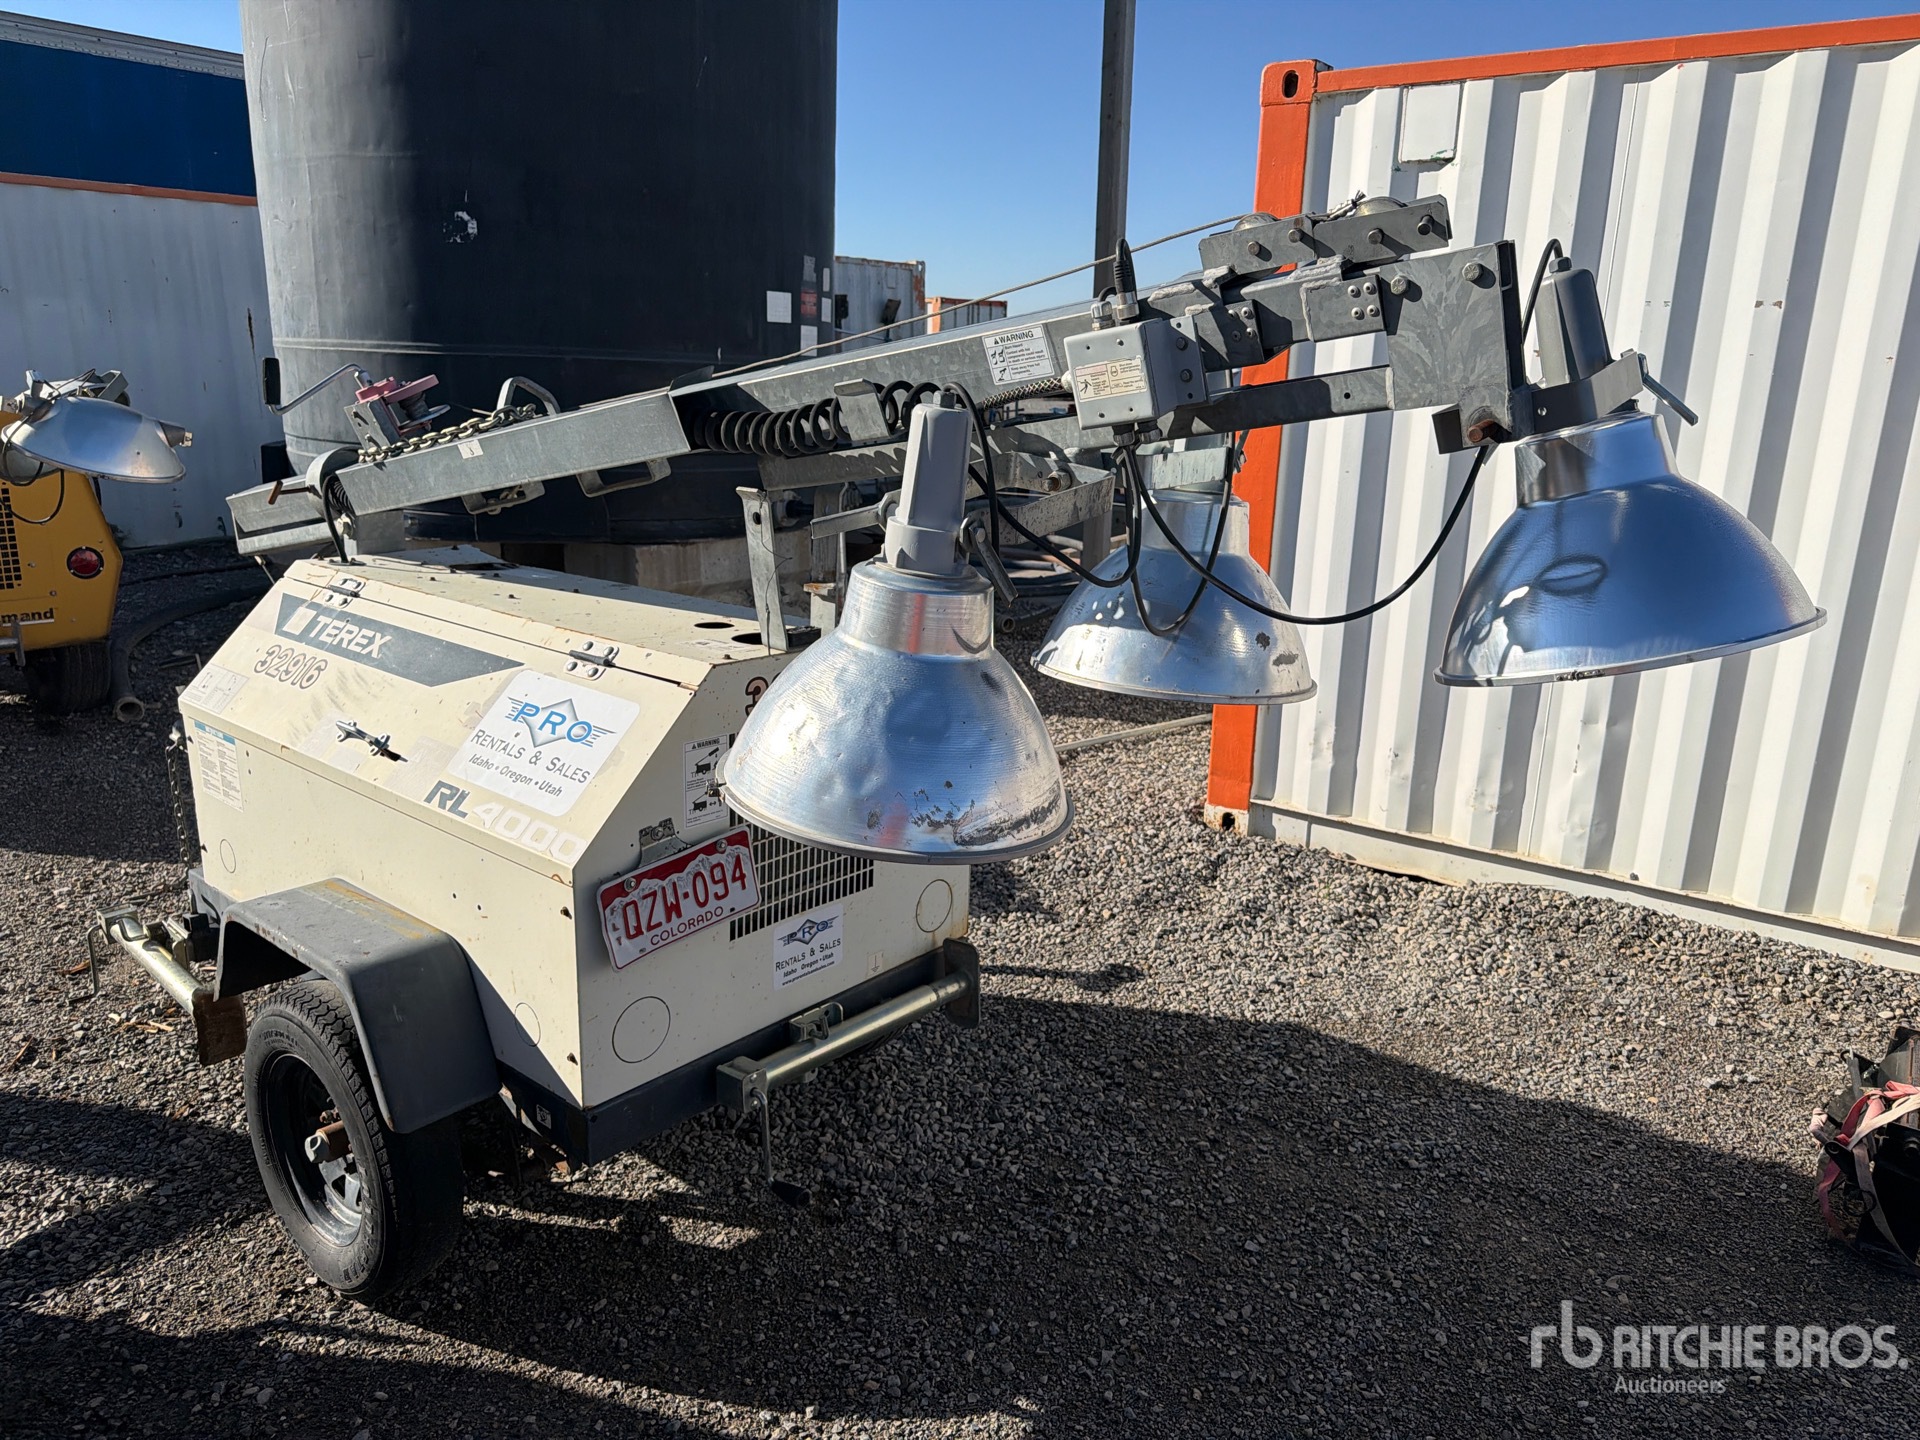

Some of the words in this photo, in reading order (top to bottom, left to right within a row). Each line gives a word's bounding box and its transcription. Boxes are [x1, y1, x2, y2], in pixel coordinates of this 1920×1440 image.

[998, 330, 1034, 344] WARNING
[0, 607, 54, 623] mand
[309, 614, 392, 659] TEREX
[253, 644, 329, 689] 32916
[512, 701, 592, 743] PRO
[470, 728, 525, 760] RENTALS
[528, 749, 542, 765] &
[545, 756, 591, 784] SALES
[697, 738, 720, 749] WARNING
[469, 753, 495, 771] Idaho
[501, 766, 534, 788] Oregon
[539, 781, 563, 798] Utah
[424, 780, 468, 818] RL
[471, 802, 588, 864] 4000
[650, 906, 724, 946] COLORADO
[787, 920, 829, 945] PRO
[775, 952, 806, 972] RENTALS
[809, 947, 816, 957] &
[819, 938, 841, 953] SALES
[783, 967, 798, 978] Idaho
[800, 959, 819, 970] Oregon
[822, 952, 834, 961] Utah
